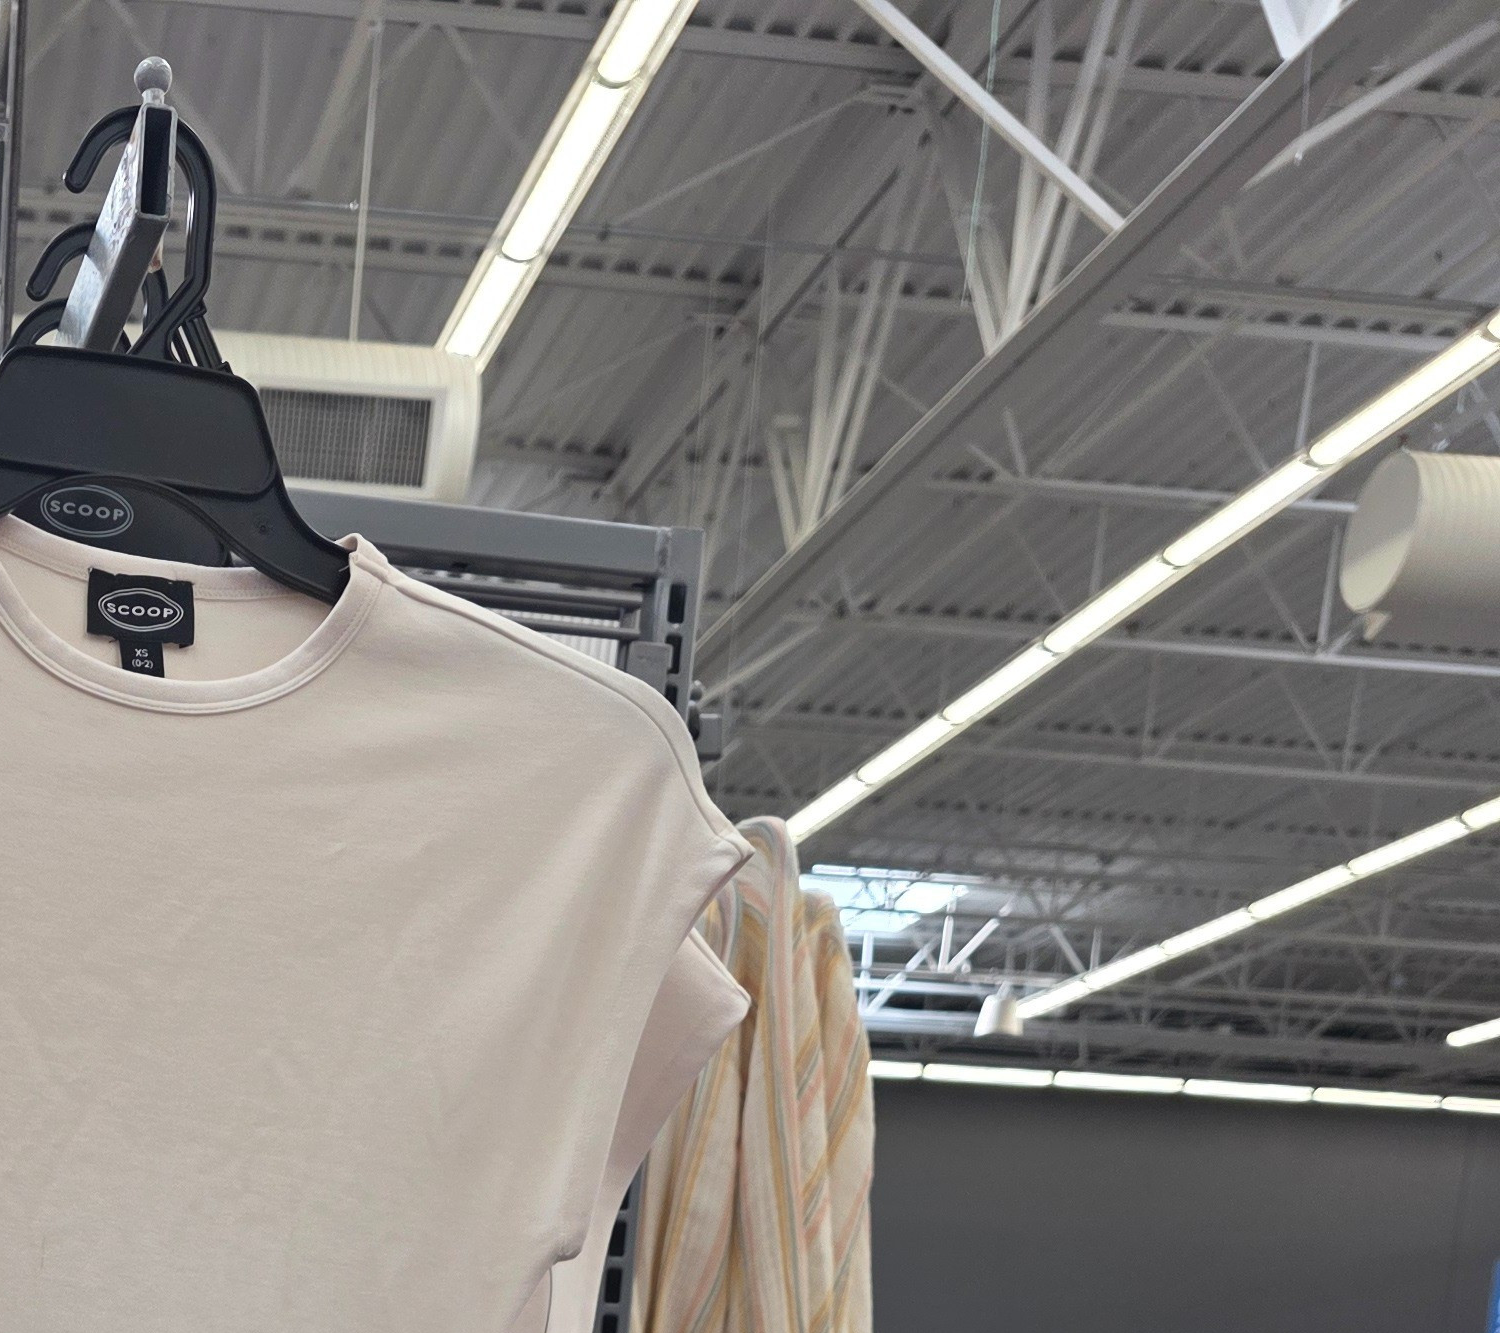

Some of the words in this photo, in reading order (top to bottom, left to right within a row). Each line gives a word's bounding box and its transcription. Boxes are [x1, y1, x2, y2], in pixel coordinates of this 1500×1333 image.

[50, 500, 124, 521] SCOOP
[106, 602, 174, 618] SCOOP
[134, 648, 149, 657] XS
[131, 659, 153, 669] (0-2)
